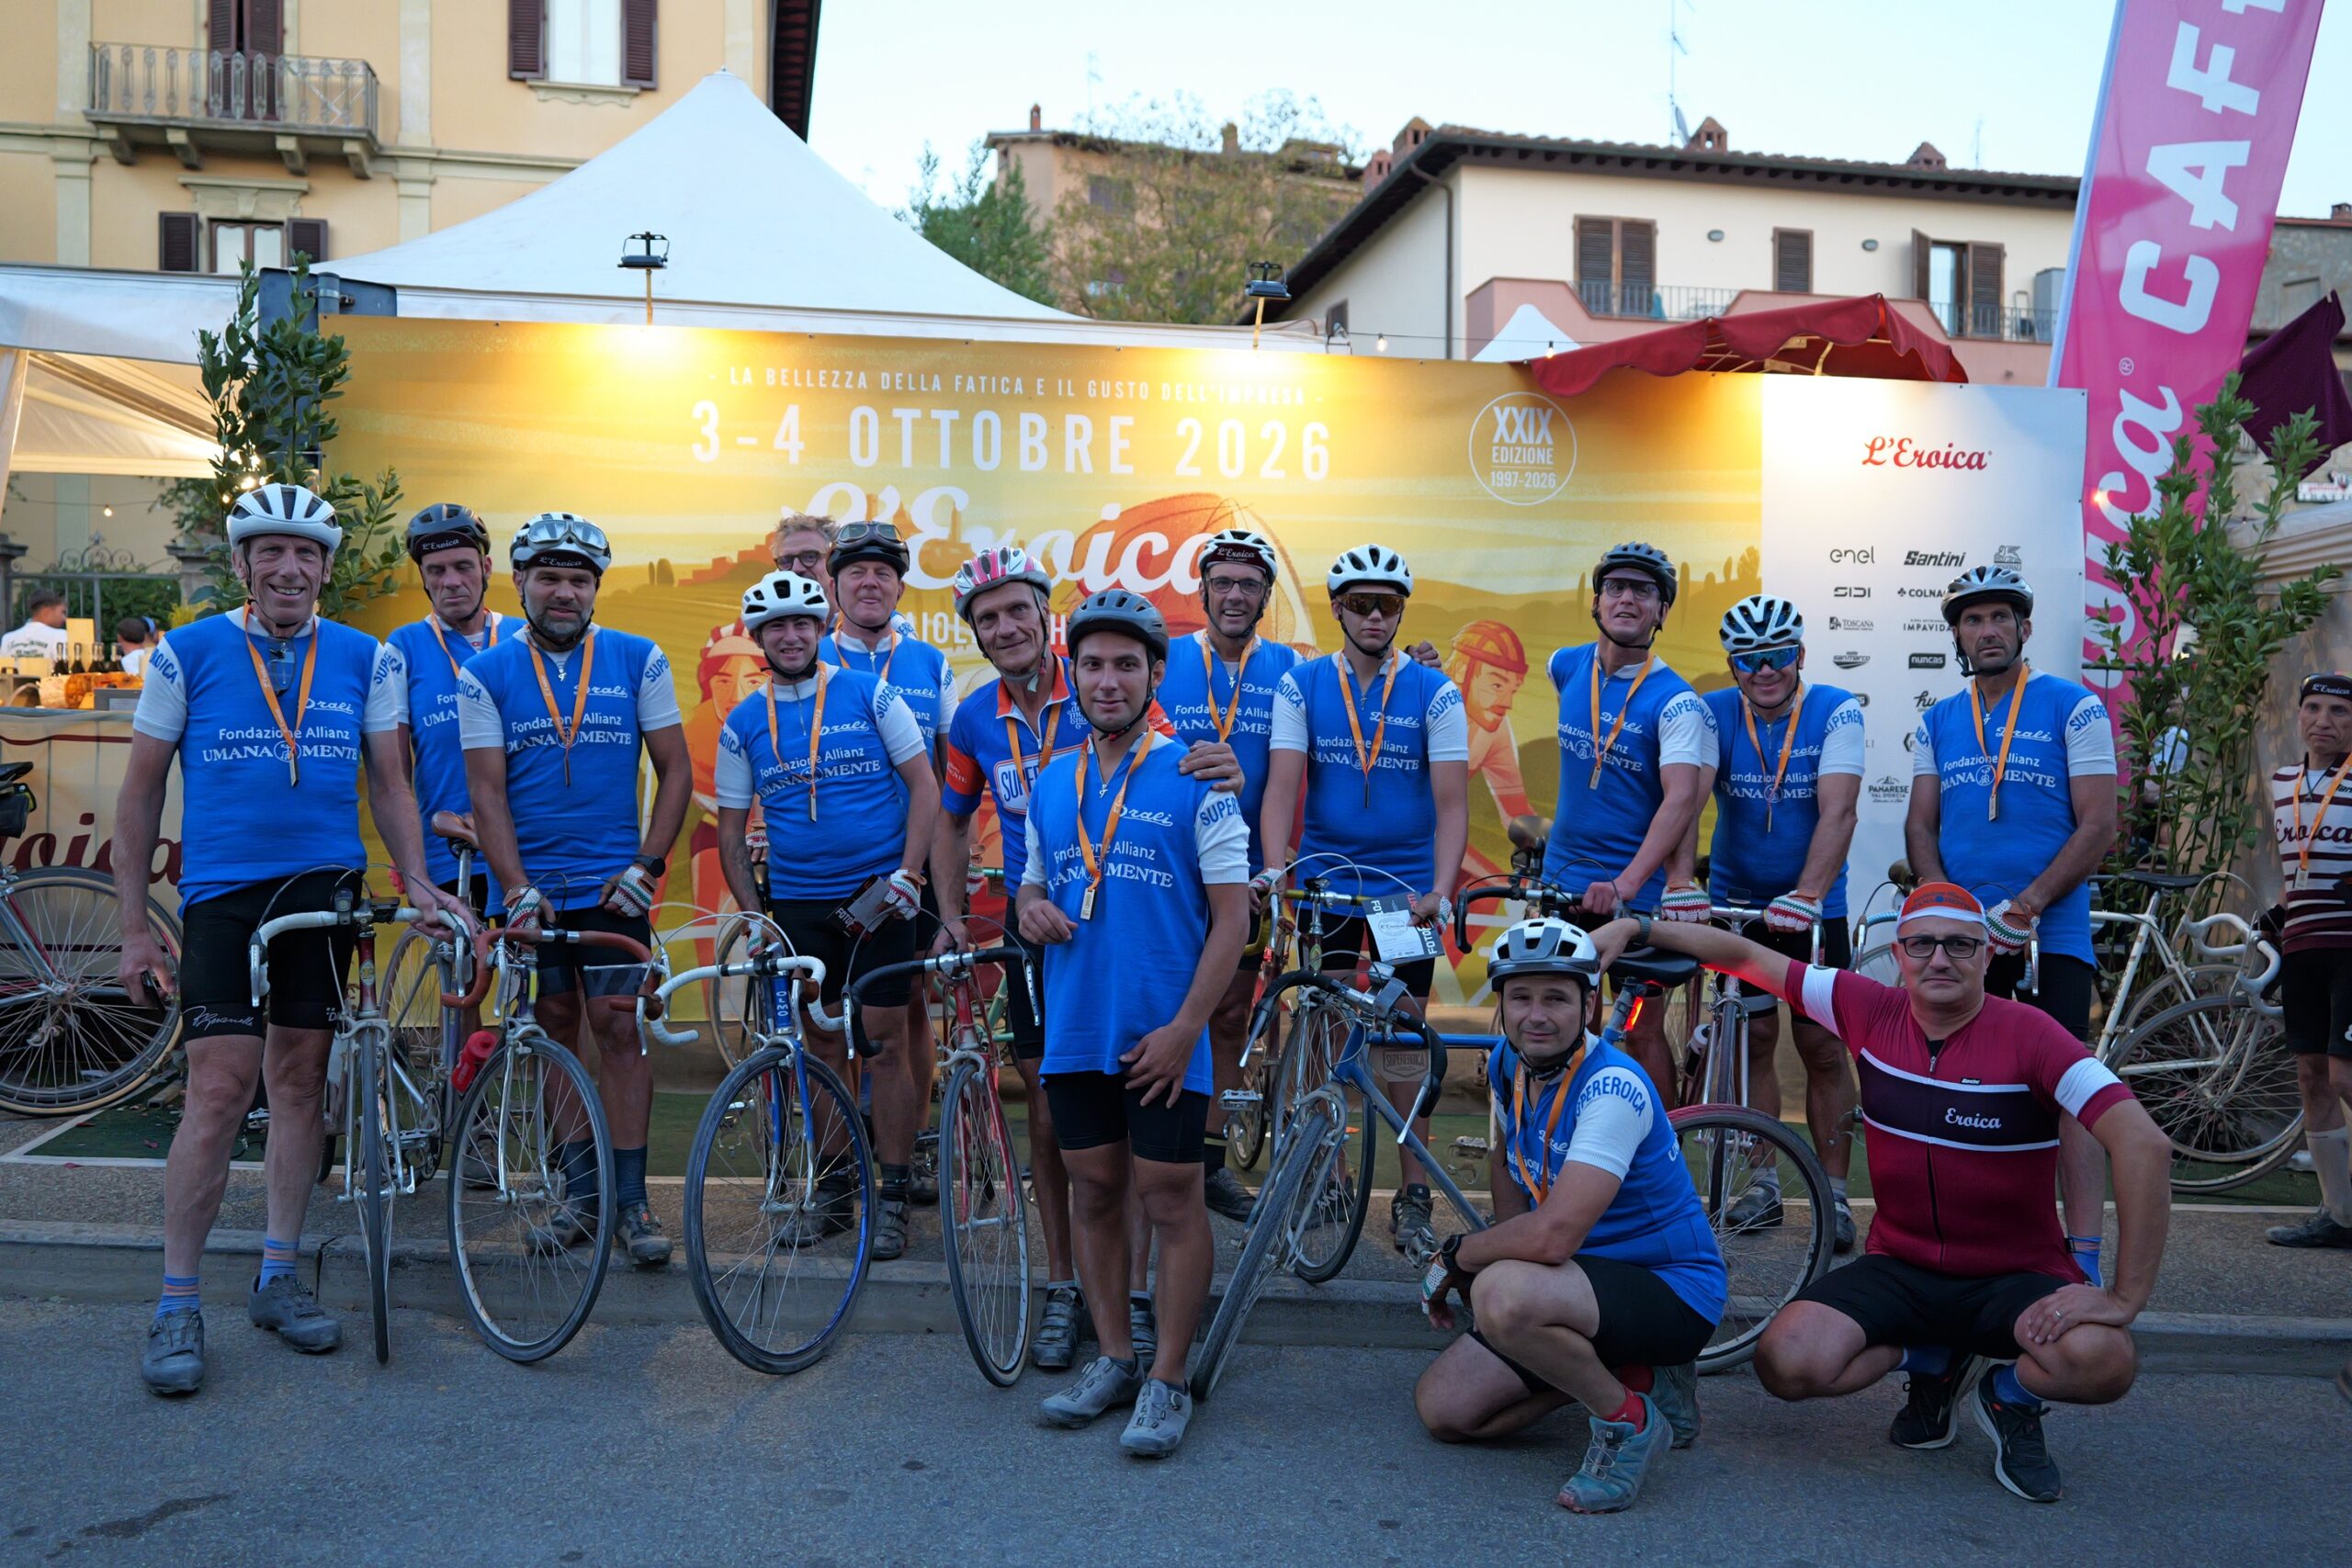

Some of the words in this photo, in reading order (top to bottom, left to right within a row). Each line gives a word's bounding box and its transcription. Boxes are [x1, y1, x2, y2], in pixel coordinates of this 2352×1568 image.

[2119, 0, 2288, 334] CAF
[730, 367, 753, 386] LA
[766, 367, 867, 389] BELLEZZA
[881, 372, 942, 391] DELLA
[955, 375, 1023, 395] FATICA
[1036, 378, 1045, 396] E
[1058, 378, 1076, 397] IL
[1088, 380, 1149, 400] GUSTO
[1161, 382, 1306, 406] DELL'IMPRESA
[1492, 406, 1554, 446] XXIX
[849, 405, 1135, 475] OTTOBRE
[1175, 416, 1329, 481] 2026
[1491, 446, 1555, 465] EDIZIONE
[1862, 435, 1988, 470] L'Eroica
[1490, 470, 1556, 489] 1997-2026
[422, 538, 460, 551] L'Eroica
[1216, 547, 1255, 558] L'Eroica
[538, 556, 582, 568] L'Eroica
[1829, 546, 1875, 564] enel
[1904, 550, 1966, 567] Santini
[1834, 587, 1871, 598] SIDI
[1842, 619, 1874, 627] TOSCANA
[1911, 656, 1943, 664] nuncas
[582, 713, 622, 726] Allianz
[305, 726, 350, 740] Allianz
[579, 730, 632, 746] MENTE
[203, 745, 274, 762] UMANA
[302, 745, 358, 761] MENTE
[824, 747, 865, 762] Allianz
[2003, 751, 2040, 767] llianz
[823, 760, 881, 778] MENTE
[1113, 840, 1156, 861] Allianz
[1106, 862, 1175, 888] MENTE
[775, 990, 789, 1017] OLMO
[1945, 1107, 2002, 1129] Eroica
